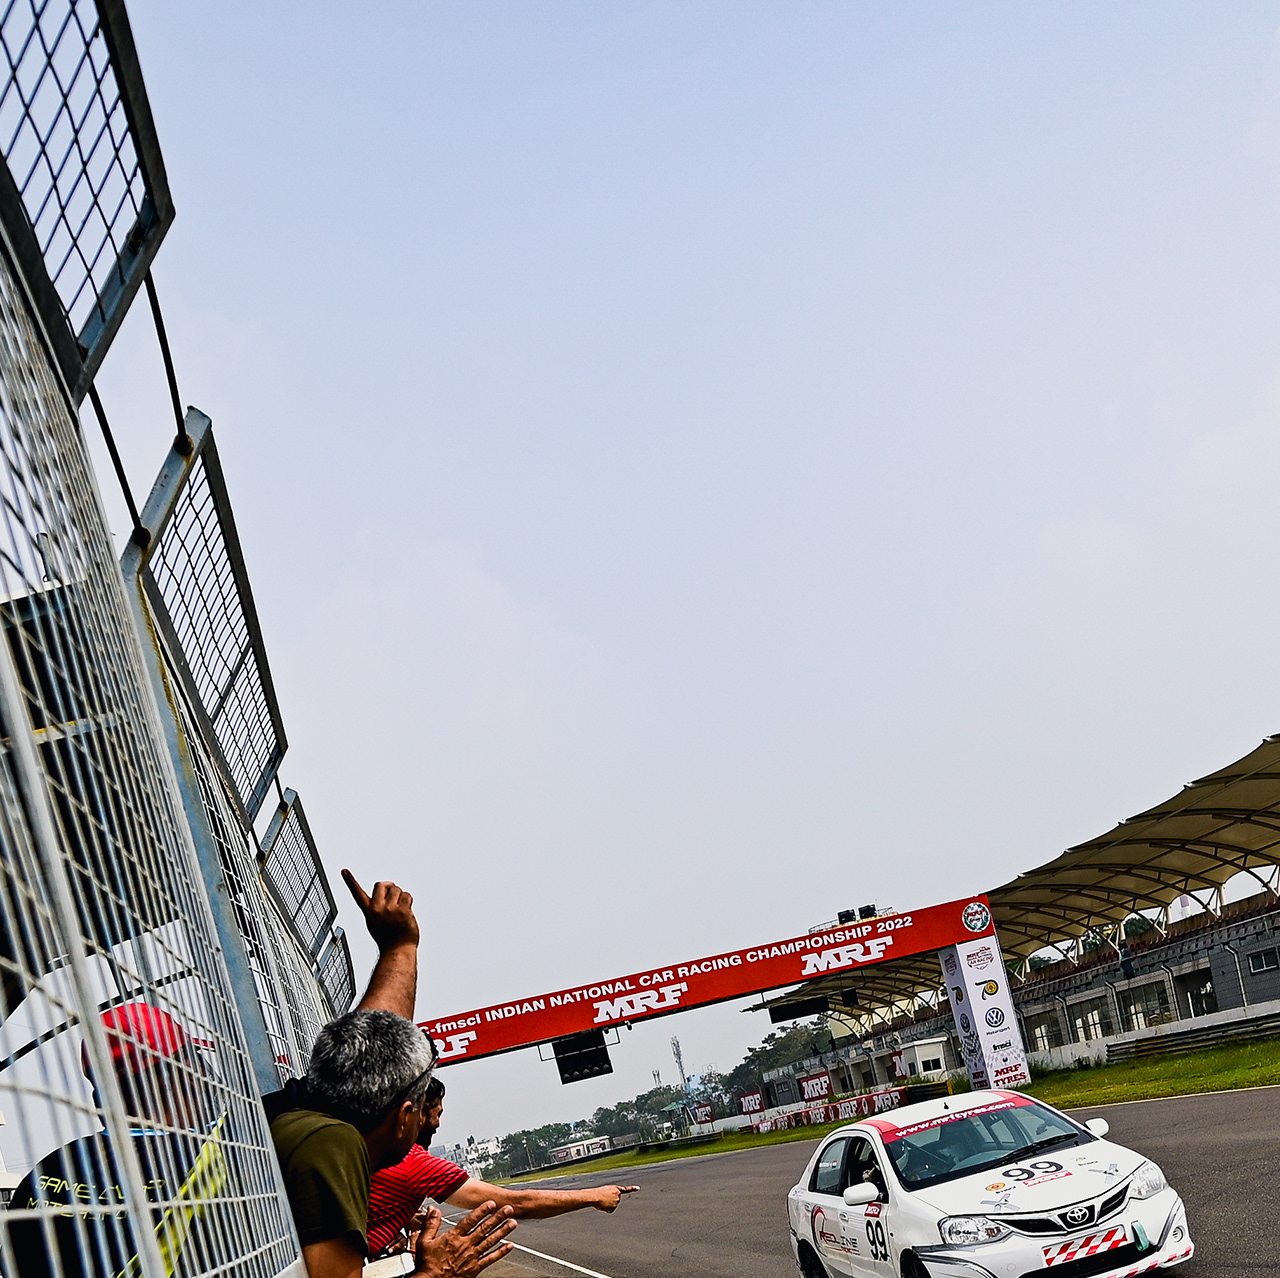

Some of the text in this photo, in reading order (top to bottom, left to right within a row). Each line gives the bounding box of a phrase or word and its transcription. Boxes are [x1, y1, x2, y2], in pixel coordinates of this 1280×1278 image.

[801, 935, 893, 976] MRF
[485, 999, 546, 1022] INDIAN
[549, 979, 636, 1007] NATIONAL
[639, 970, 675, 986] CAR
[677, 954, 742, 978] RACING
[746, 925, 873, 963] CHAMPIONSHIP
[876, 916, 914, 934] 2022
[593, 981, 689, 1024] MRF
[433, 1030, 478, 1059] RF
[993, 1072, 1027, 1087] TYRES
[994, 1063, 1021, 1078] MRF
[802, 1075, 830, 1101] MRF
[740, 1093, 762, 1113] MRF
[837, 1100, 858, 1119] MRF
[873, 1091, 901, 1113] MRF
[1001, 1160, 1064, 1182] 99
[865, 1219, 889, 1261] 99
